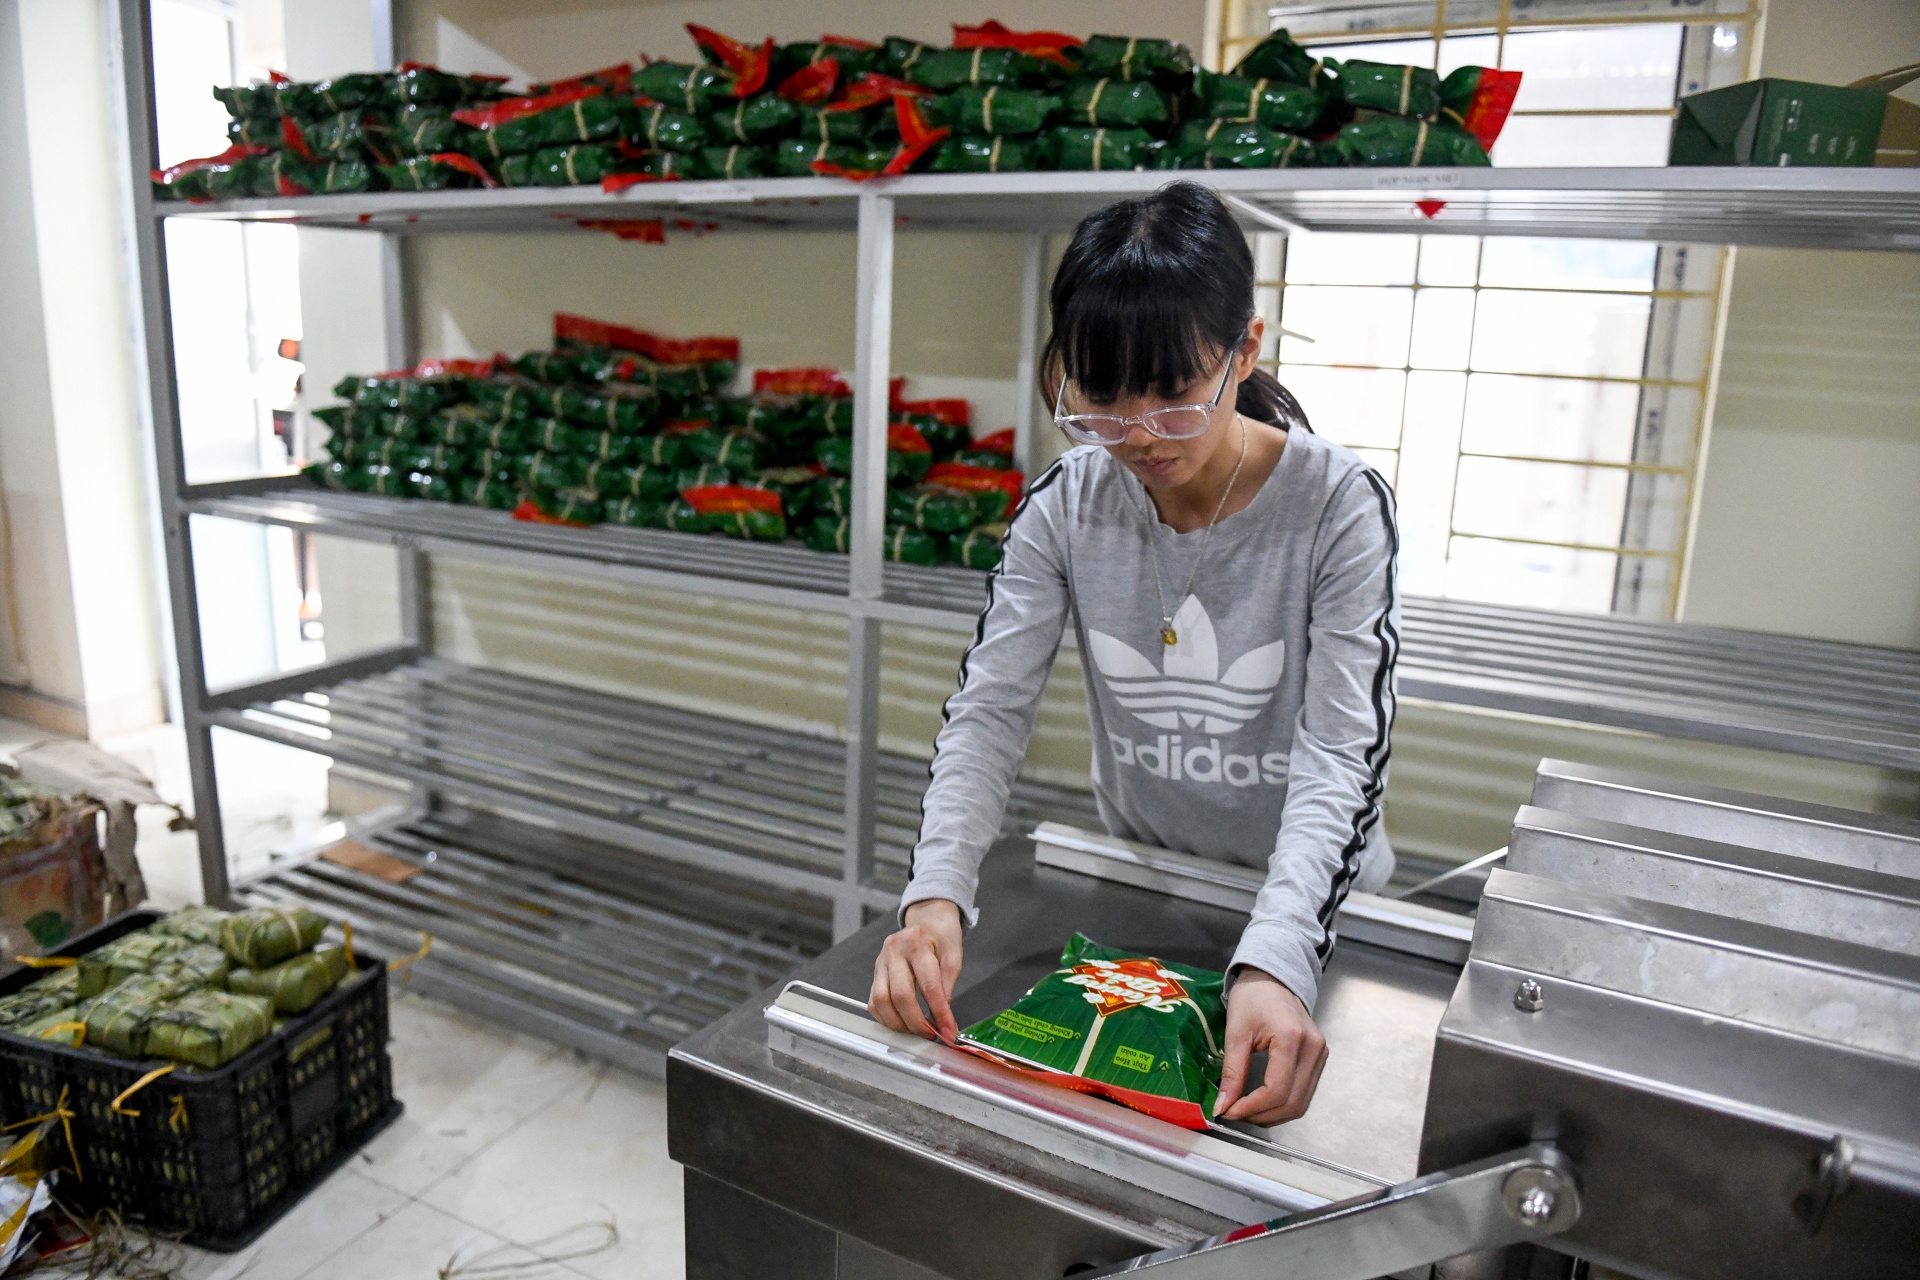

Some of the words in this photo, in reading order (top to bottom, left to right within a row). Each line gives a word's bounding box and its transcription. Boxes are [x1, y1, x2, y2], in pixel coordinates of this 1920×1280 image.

[1109, 732, 1290, 787] adidas
[1024, 1028, 1046, 1041] Không
[1049, 1025, 1071, 1037] Không
[1120, 1048, 1137, 1056] toàn
[1139, 1053, 1150, 1061] An
[1116, 1056, 1131, 1065] Heo
[1132, 1060, 1147, 1070] Thịt
